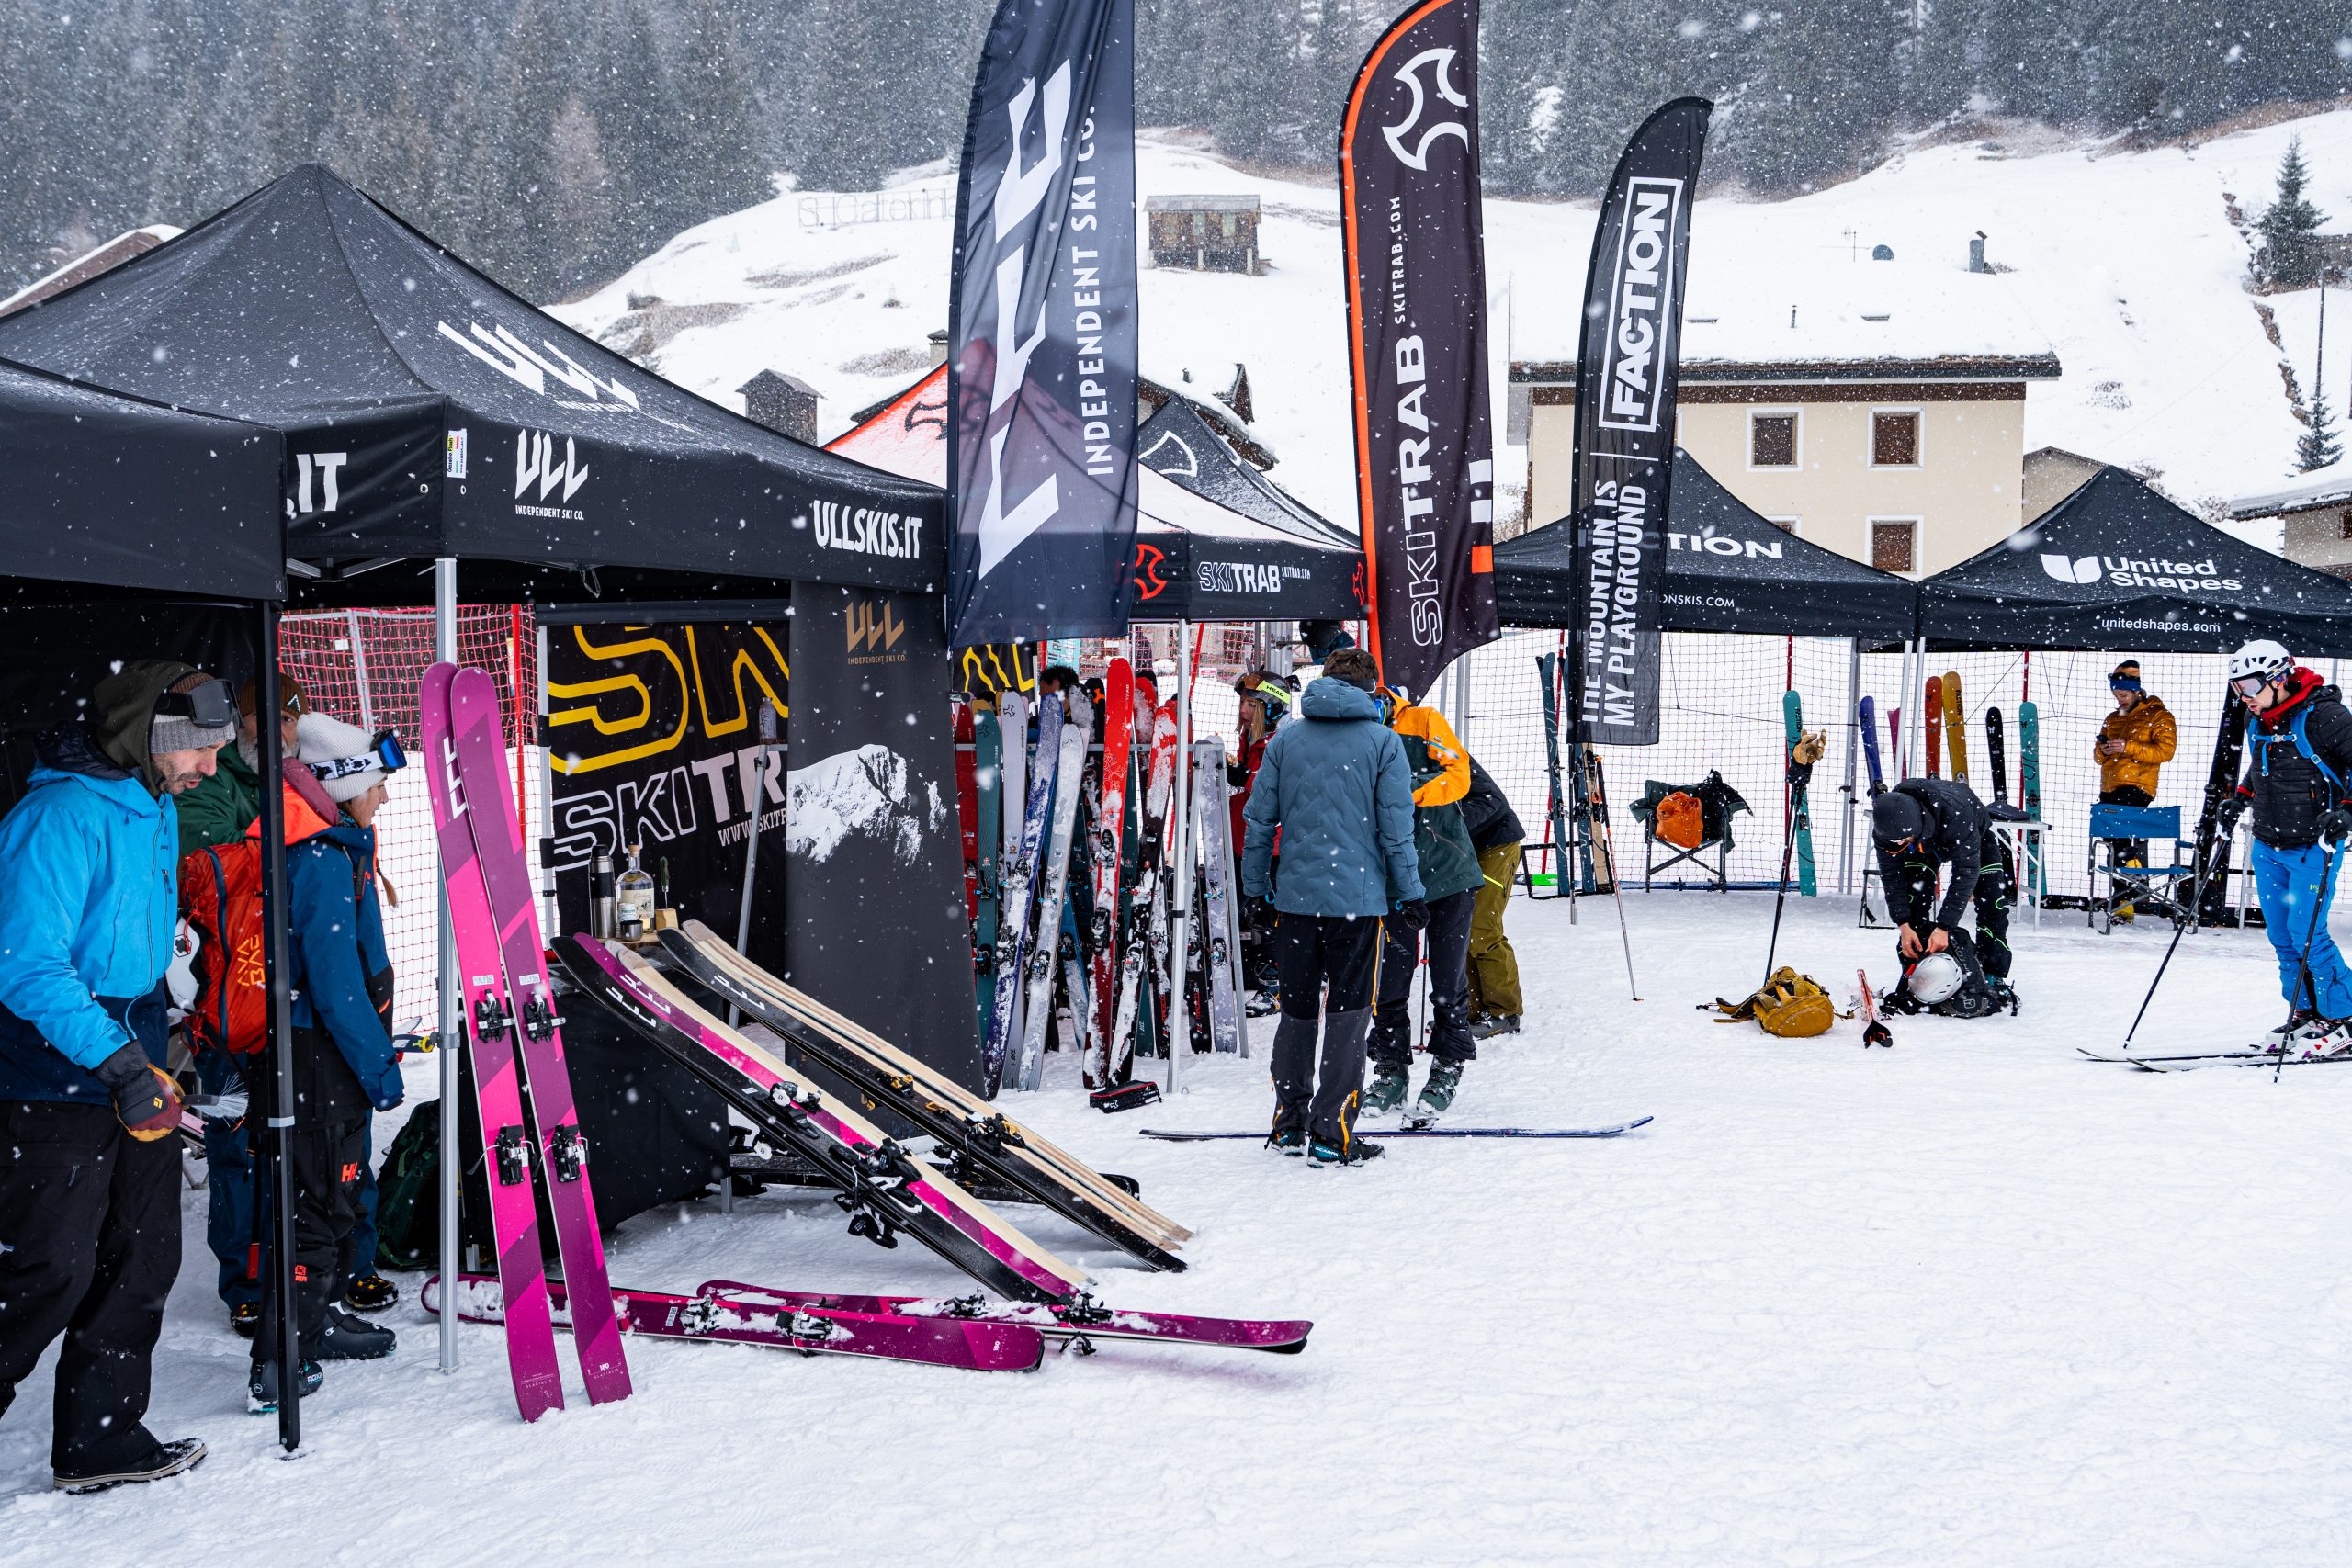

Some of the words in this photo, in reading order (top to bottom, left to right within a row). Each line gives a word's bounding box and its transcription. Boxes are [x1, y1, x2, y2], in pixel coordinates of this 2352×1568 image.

[1070, 175, 1097, 231] SKI
[1391, 196, 1407, 324] SKITRAB.COM
[1611, 192, 1669, 417] FACTION
[1071, 244, 1114, 475] INDEPENDENT
[1396, 334, 1443, 648] SKITRAB
[1594, 479, 1618, 508] IS
[514, 504, 561, 518] INDEPENDENT
[561, 509, 573, 520] SKI
[573, 510, 585, 521] CO.
[813, 500, 922, 559] ULLSKIS.IT
[1197, 561, 1282, 593] SKITRAB
[1607, 485, 1647, 675] PLAYGROUND
[2103, 556, 2218, 576] United
[1588, 518, 1618, 664] MOUNTAIN
[2109, 572, 2243, 594] Shapes
[2101, 617, 2221, 633] unitedshapes.com
[847, 655, 885, 665] INDEPENDENT
[885, 654, 896, 663] SKI
[1265, 684, 1284, 698] HEAD
[1602, 682, 1635, 727] MY
[1955, 689, 1963, 716] FACTION
[1794, 707, 1803, 733] FACTION
[1314, 1146, 1340, 1157] SCARPA
[598, 1362, 611, 1371] 180
